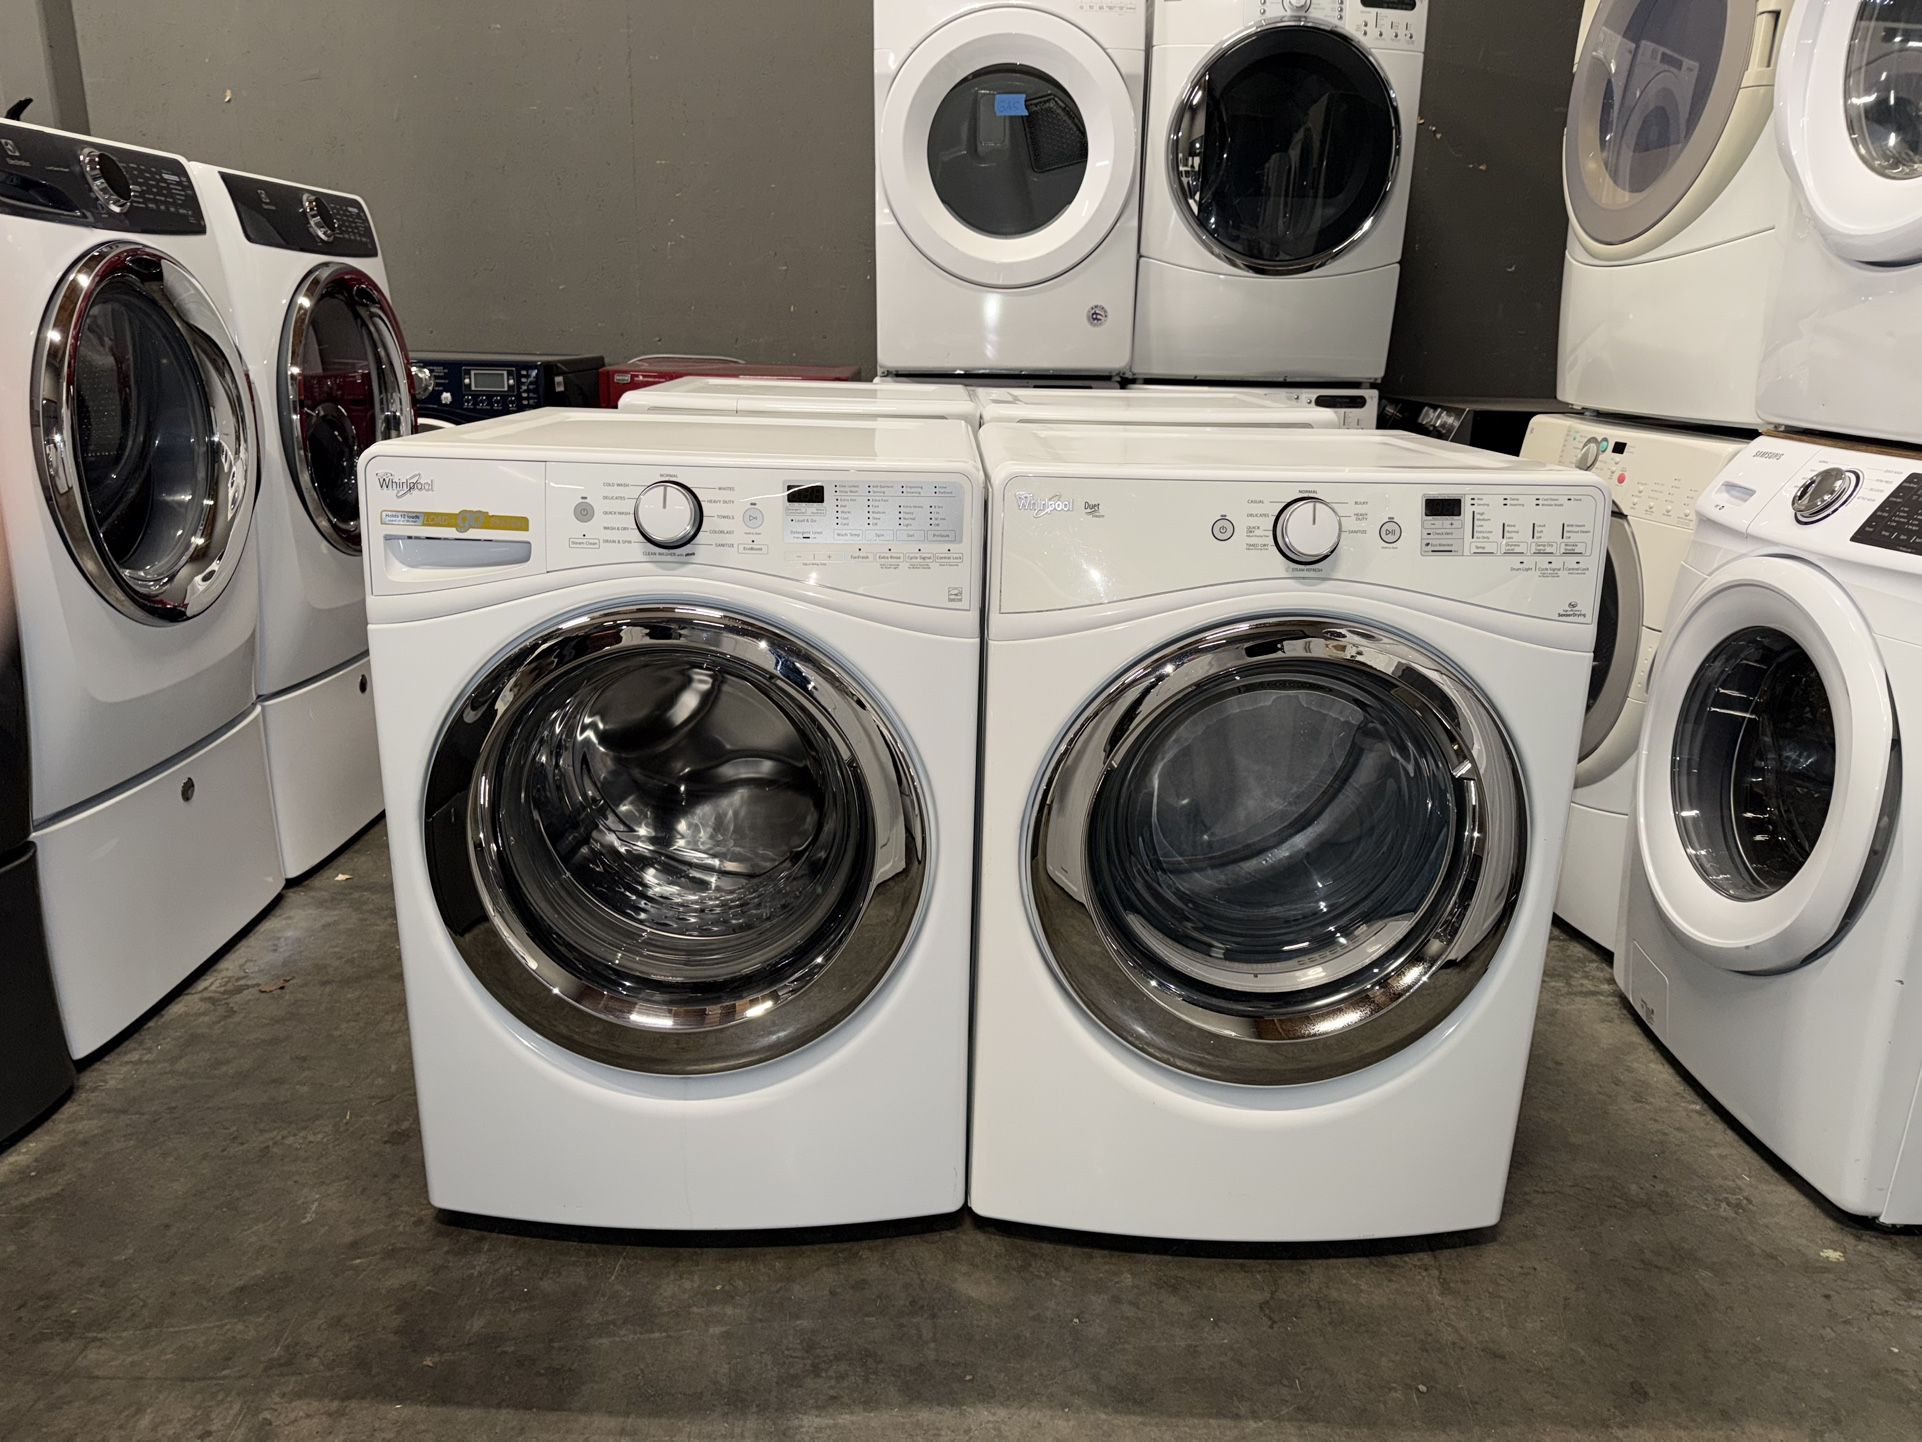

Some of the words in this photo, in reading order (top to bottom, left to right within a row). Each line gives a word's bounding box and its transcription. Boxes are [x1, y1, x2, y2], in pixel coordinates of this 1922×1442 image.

[1752, 450, 1785, 461] SAMSUNG
[376, 474, 435, 495] Whirlpool
[1016, 493, 1074, 513] Whirlpool
[1084, 501, 1100, 511] Duet
